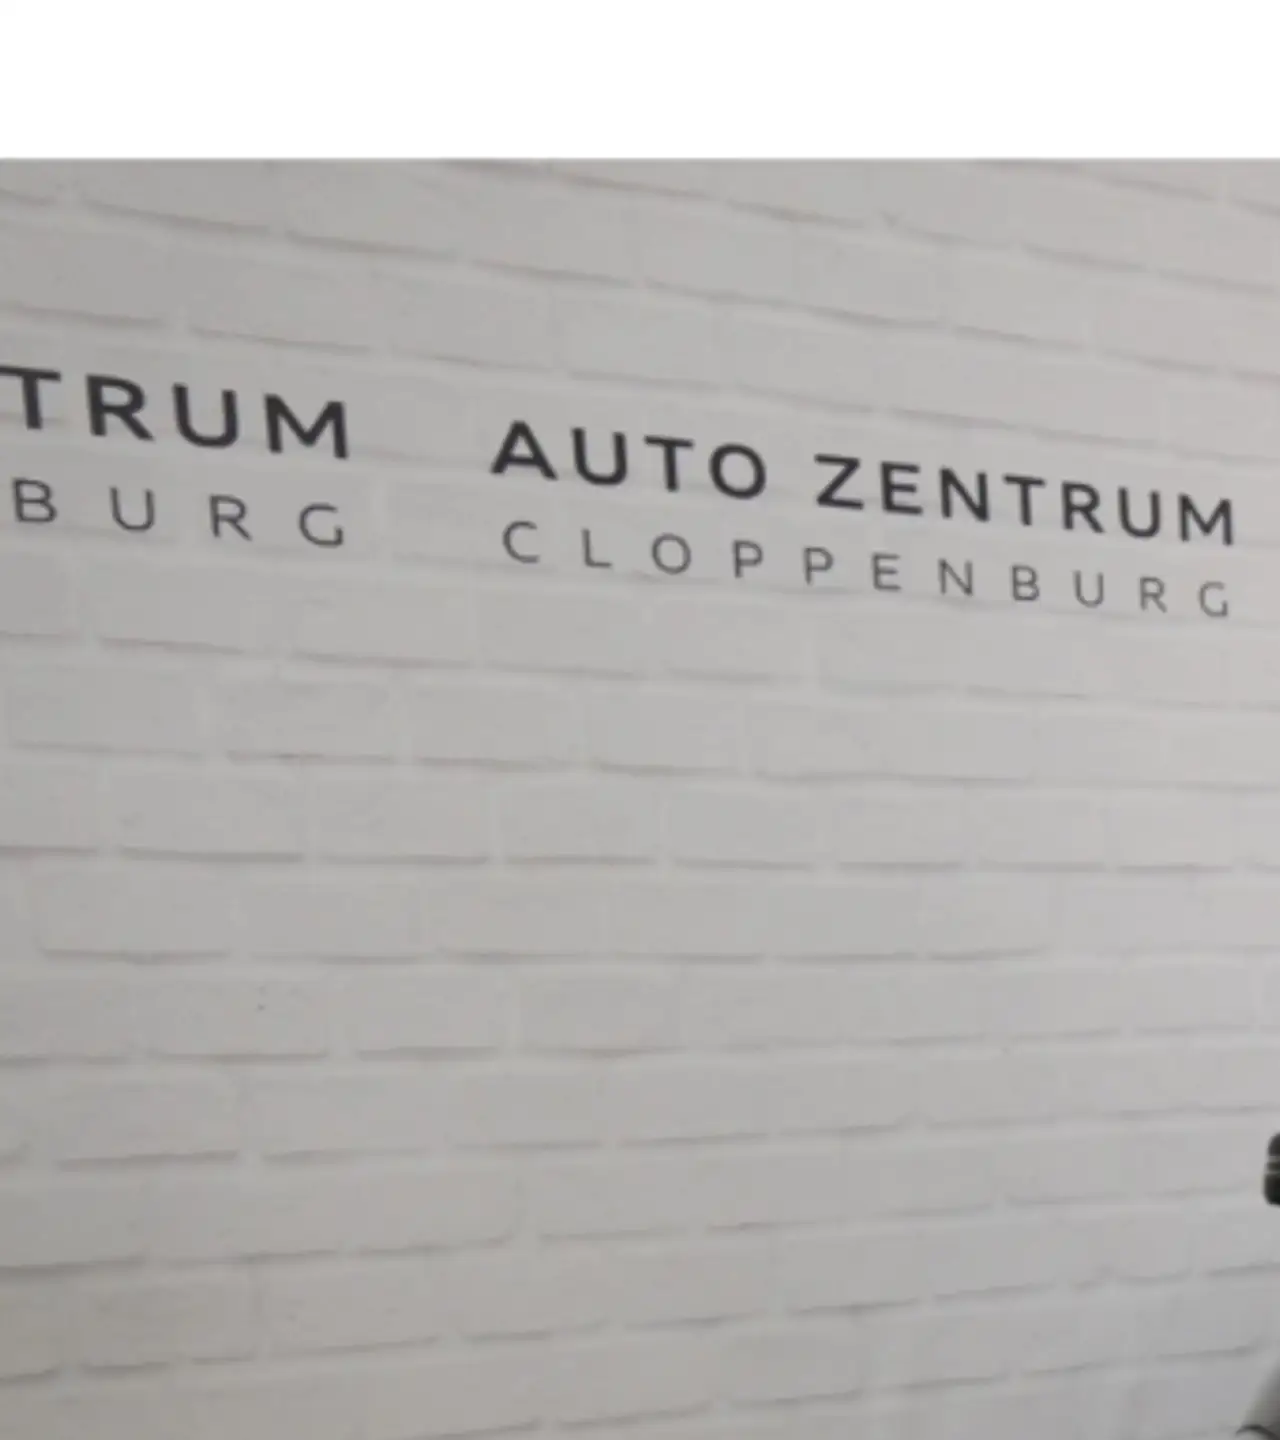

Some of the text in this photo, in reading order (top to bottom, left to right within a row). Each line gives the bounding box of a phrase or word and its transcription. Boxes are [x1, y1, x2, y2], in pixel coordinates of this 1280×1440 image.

[490, 420, 1233, 546] AUTO ZENTRUM
[501, 520, 1228, 618] CLOPPENBURG
